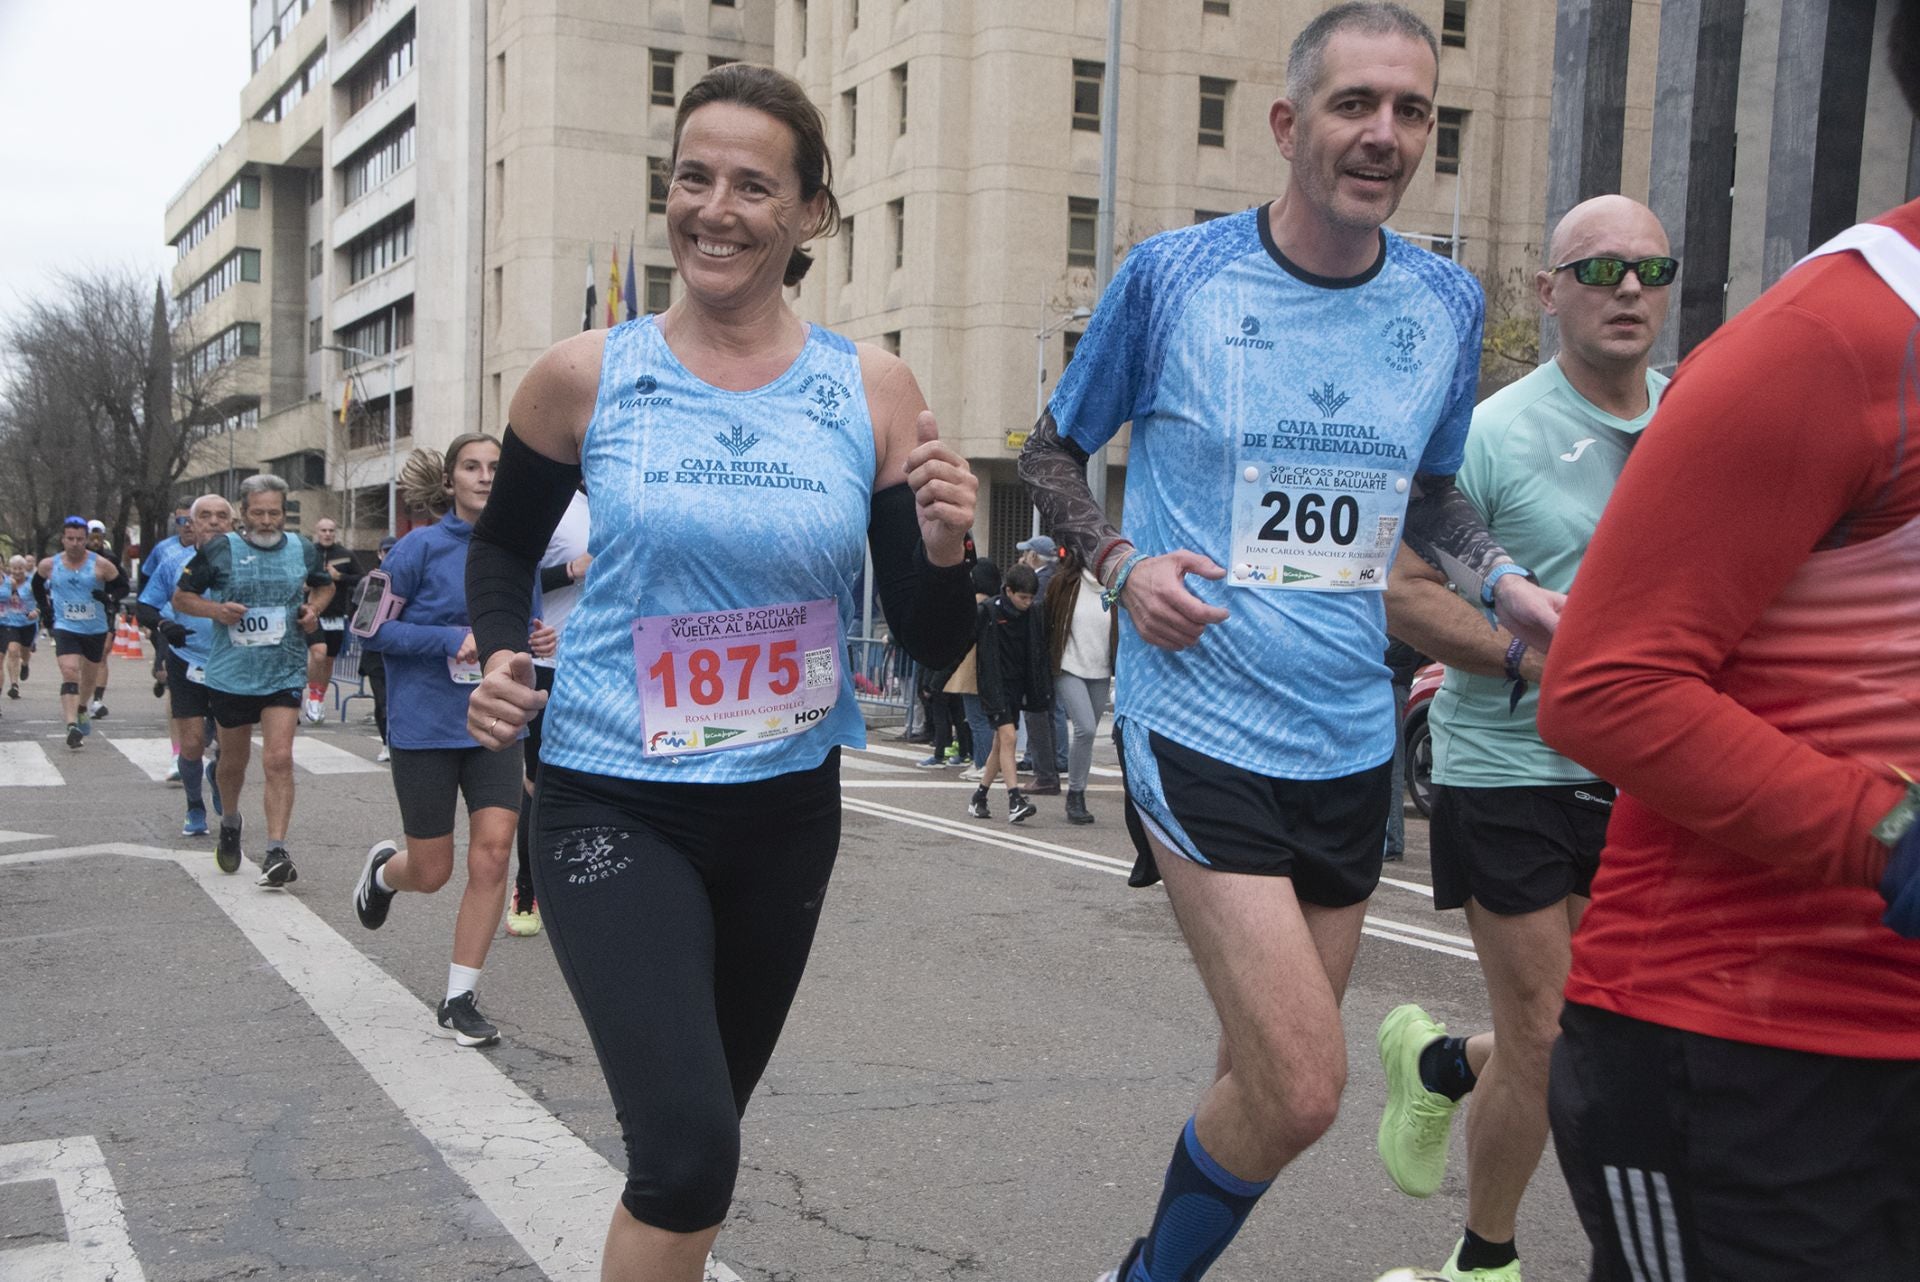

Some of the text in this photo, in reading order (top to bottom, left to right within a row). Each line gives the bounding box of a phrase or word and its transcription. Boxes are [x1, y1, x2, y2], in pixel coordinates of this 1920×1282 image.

[1381, 320, 1395, 337] CLUB
[1224, 336, 1274, 350] VIATOR
[798, 373, 853, 400] CLUB MARATON
[618, 397, 673, 410] VIATOR
[805, 409, 850, 430] BADAJOZ
[1277, 419, 1380, 440] CAJA RURAL
[1243, 433, 1408, 460] DE EXTREMADURA
[680, 458, 794, 475] CAJA RURAL
[1294, 466, 1334, 477] CROSS
[1337, 469, 1388, 480] POPULAR
[643, 471, 829, 494] DE EXTREMADURA
[1270, 473, 1312, 486] VUELTA
[1315, 477, 1330, 487] AL
[1333, 477, 1387, 490] BALUARTE
[1257, 490, 1359, 546] 260
[67, 603, 87, 613] 238
[697, 612, 744, 625] CROSS
[748, 605, 807, 620] POPULAR
[237, 615, 269, 633] 300
[672, 623, 721, 638] VUELTA
[725, 622, 742, 634] AL
[746, 613, 807, 632] BALUARTE
[649, 639, 800, 708] 1875
[795, 705, 831, 725] HOY
